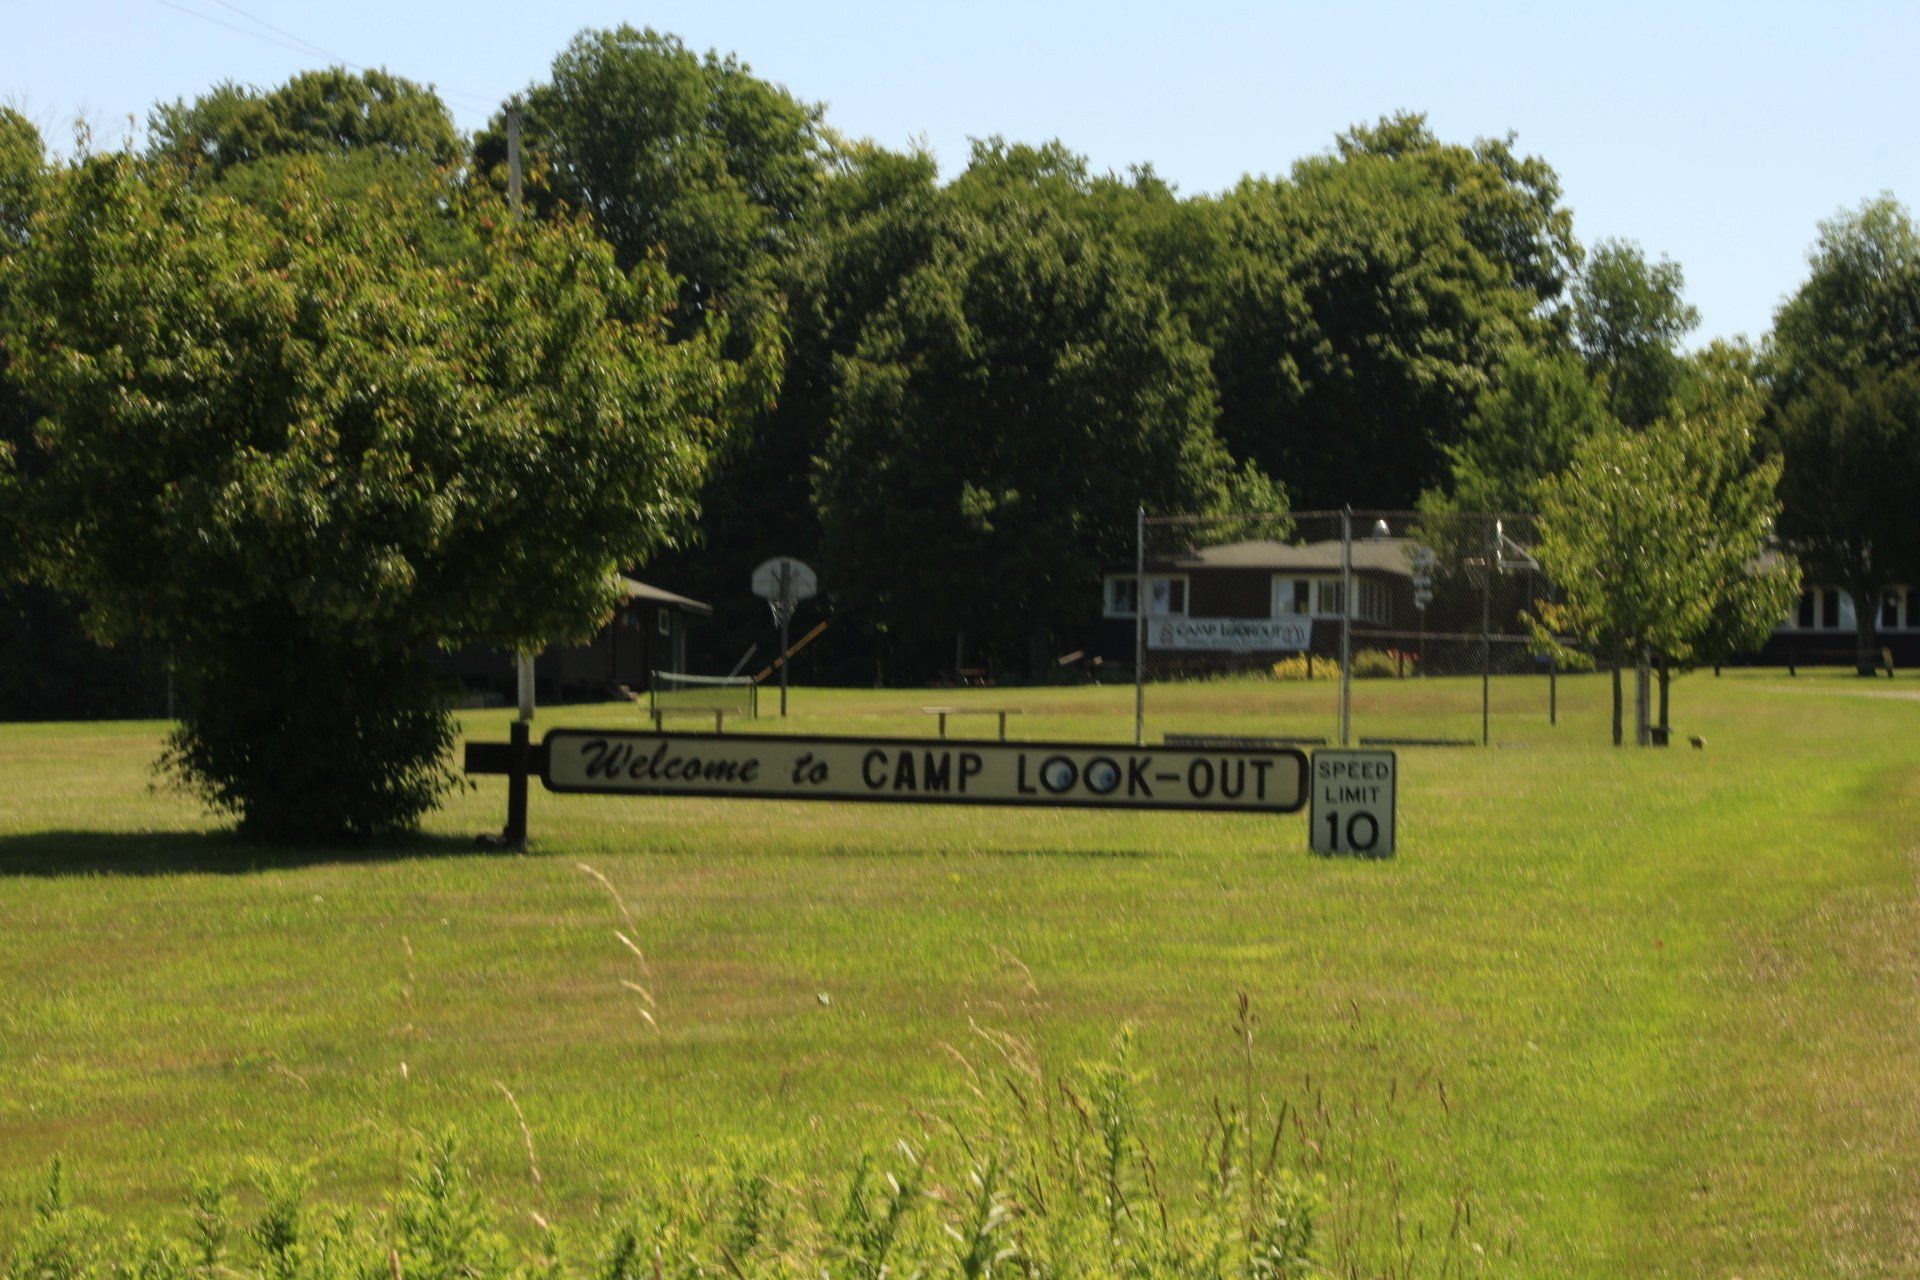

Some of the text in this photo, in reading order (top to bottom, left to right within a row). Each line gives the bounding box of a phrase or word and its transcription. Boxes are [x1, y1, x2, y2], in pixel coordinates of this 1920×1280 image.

[580, 738, 1274, 800] Welcome to CAMP LOOK-OUT
[1318, 760, 1390, 781] SPEED
[1324, 785, 1381, 804] LIMIT
[1325, 809, 1381, 852] 10
